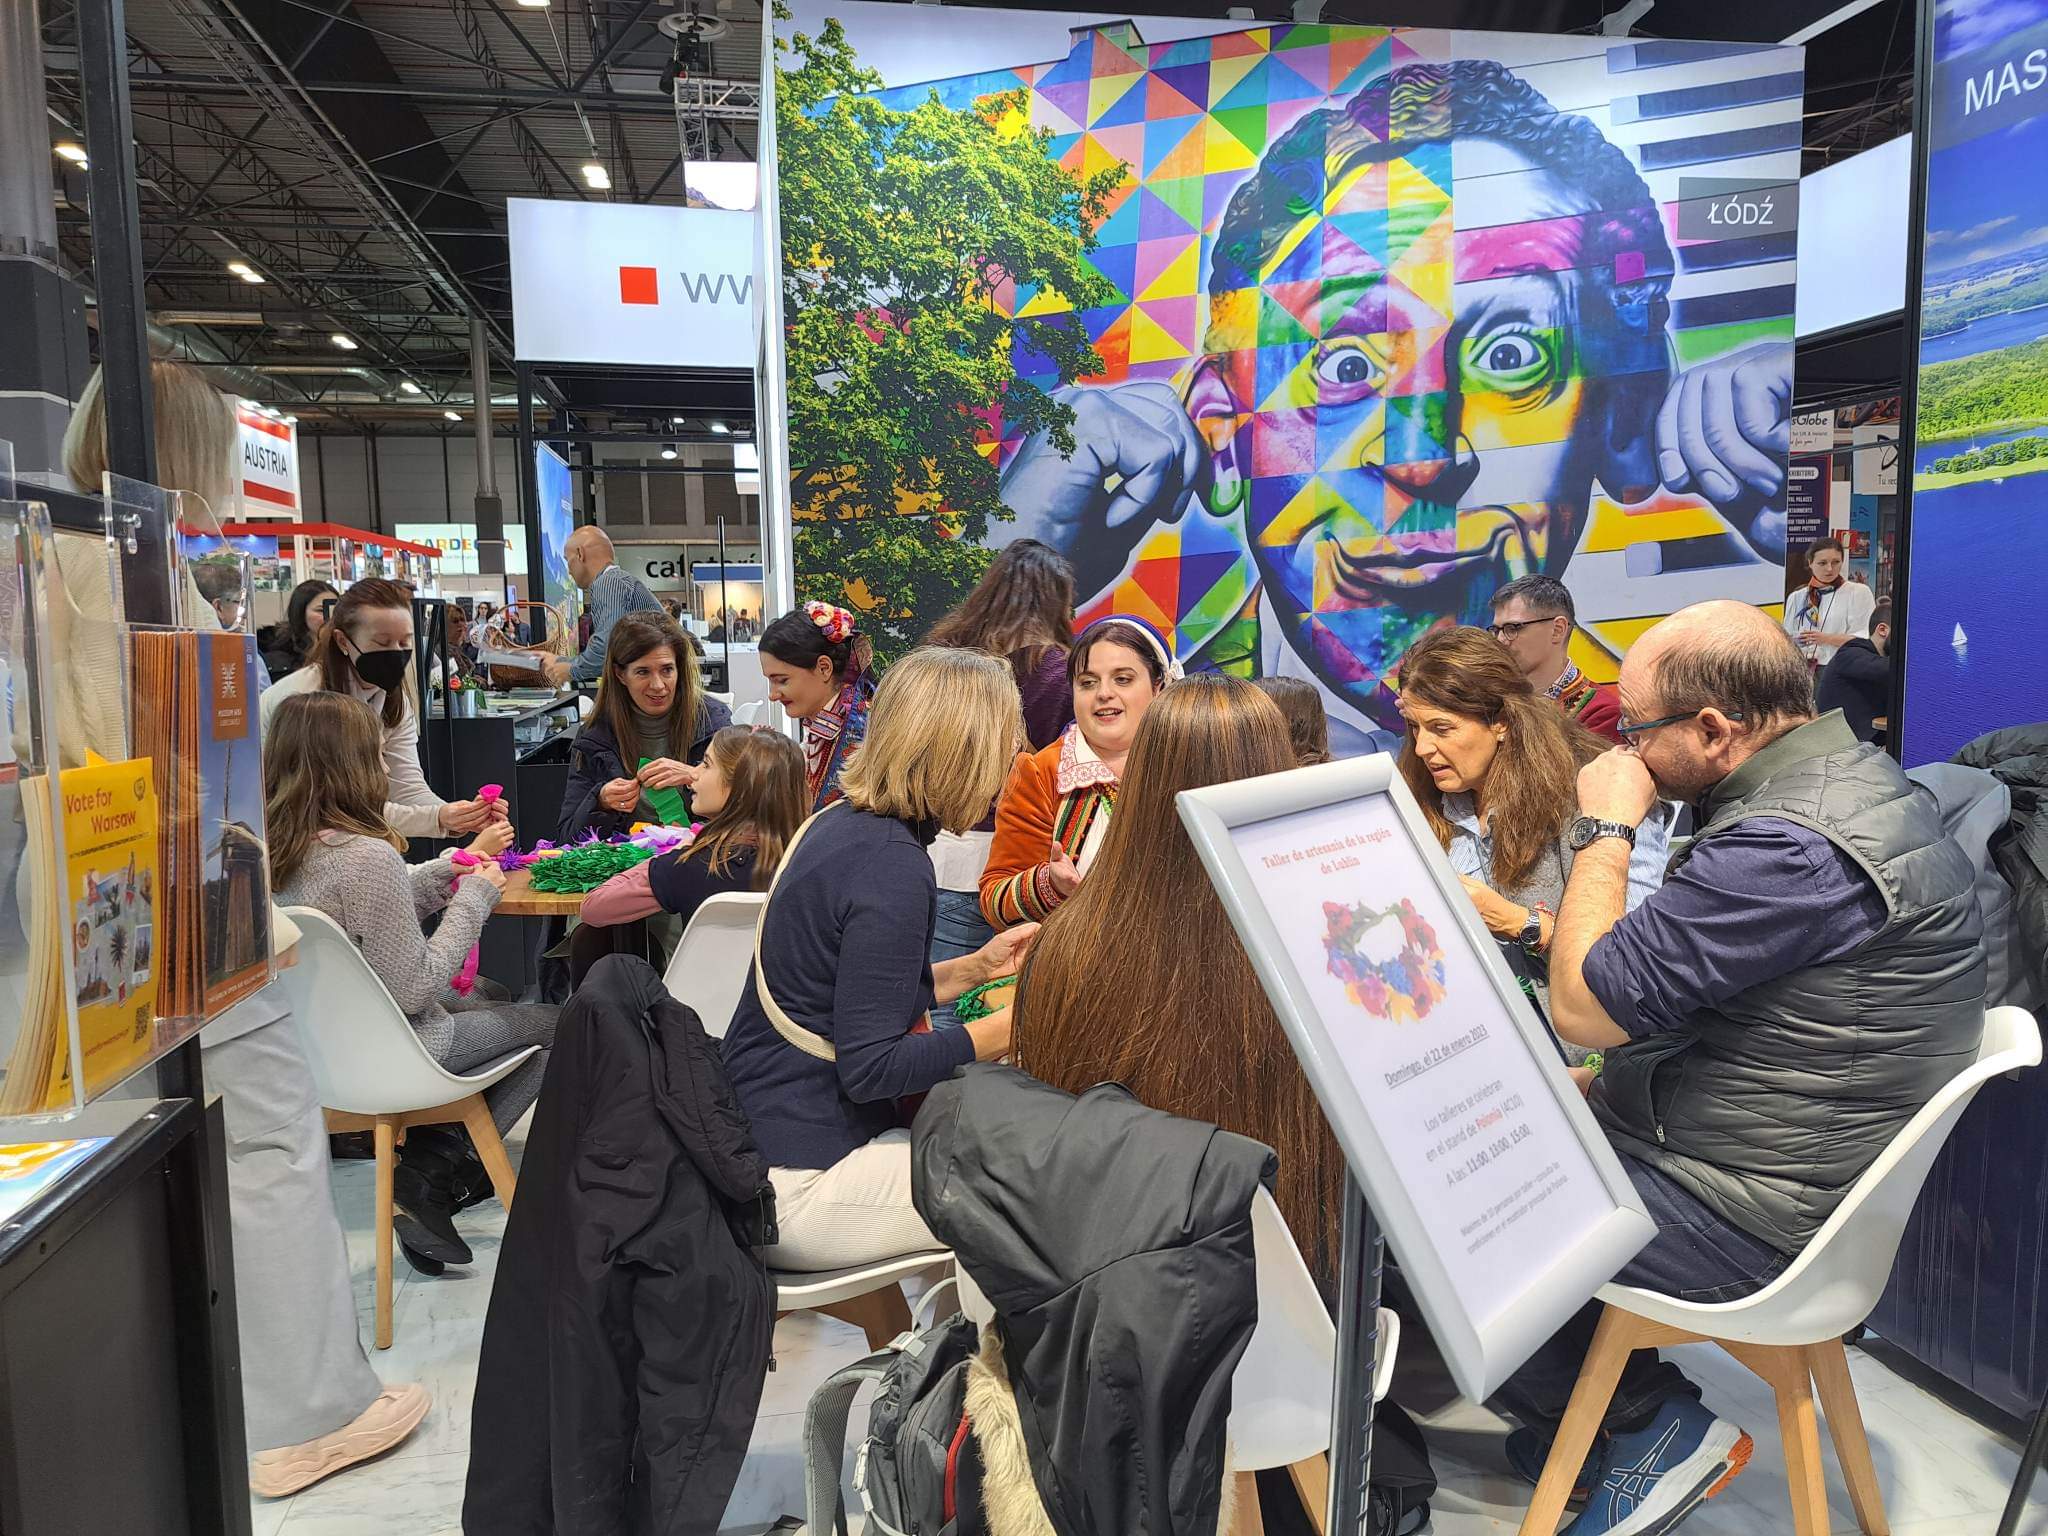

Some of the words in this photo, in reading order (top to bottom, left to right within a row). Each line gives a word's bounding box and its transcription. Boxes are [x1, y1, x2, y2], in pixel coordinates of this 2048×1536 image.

[1965, 48, 2047, 115] MAS
[1707, 194, 1774, 225] ŁÓDŹ
[245, 440, 288, 477] AUSTRIA
[65, 793, 95, 815] Vote
[96, 787, 112, 808] for
[91, 810, 136, 834] Warsaw
[1262, 854, 1290, 868] Taller
[1292, 849, 1304, 861] de
[1345, 834, 1357, 848] de
[1320, 861, 1332, 874] de
[1384, 1060, 1425, 1086] Domingo,
[1423, 1050, 1433, 1066] el
[1430, 1047, 1442, 1061] 22
[1441, 1043, 1451, 1056] de
[1450, 1034, 1472, 1052] enero
[1469, 1023, 1488, 1041] 2023
[1424, 1116, 1440, 1132] Los
[1437, 1101, 1468, 1124] talleres
[1465, 1096, 1475, 1108] se
[1473, 1080, 1503, 1102] celebran
[1426, 1148, 1438, 1162] en
[1437, 1140, 1446, 1155] el
[1445, 1127, 1467, 1150] stand
[1466, 1122, 1478, 1137] de
[1446, 1172, 1456, 1188] A
